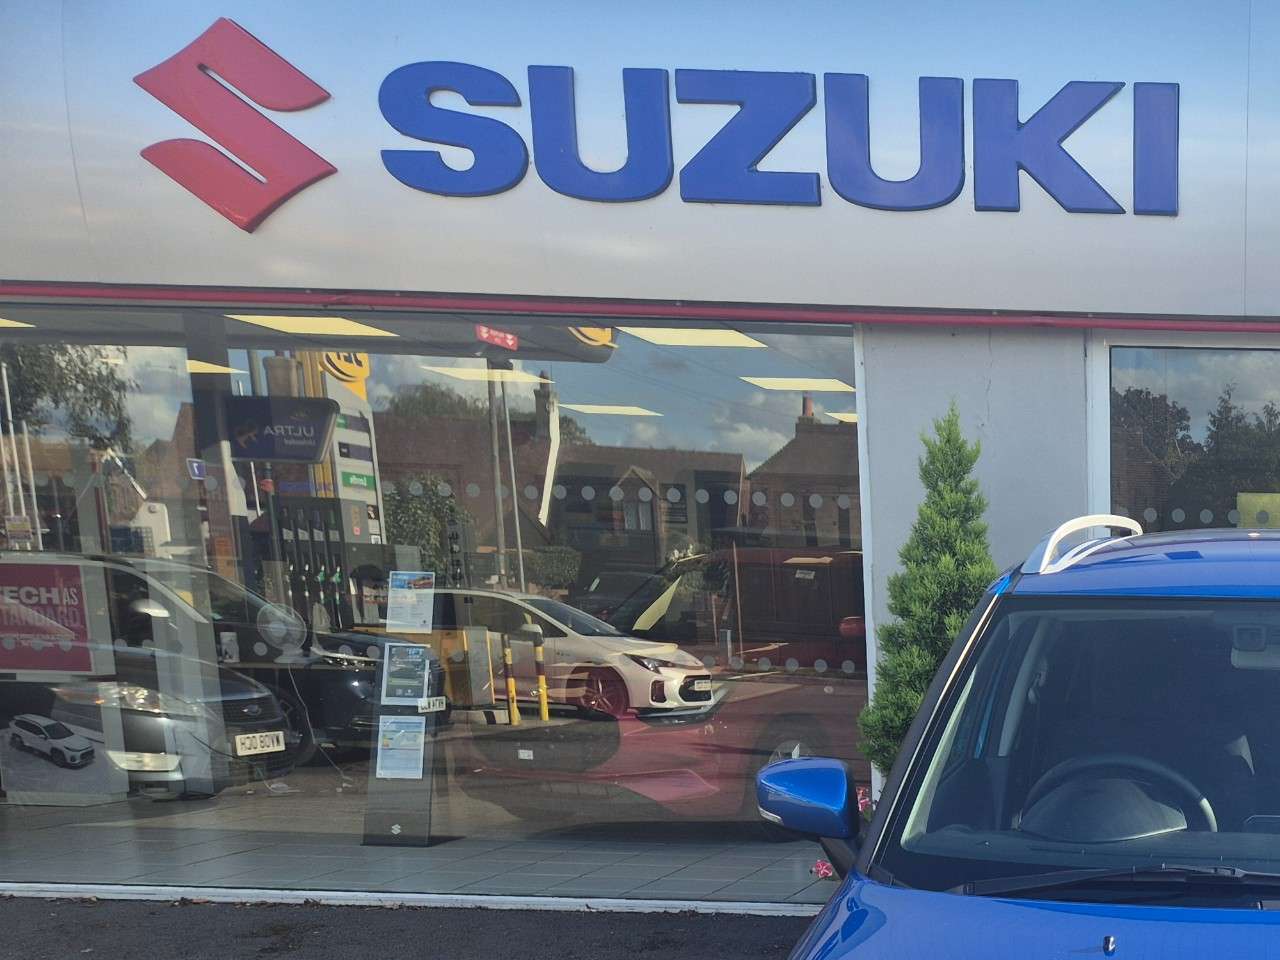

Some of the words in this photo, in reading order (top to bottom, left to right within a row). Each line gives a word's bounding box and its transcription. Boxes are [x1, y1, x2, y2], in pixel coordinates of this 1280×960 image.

[379, 60, 1181, 217] SUZUKI
[0, 586, 60, 605] ECH
[62, 587, 80, 606] AS
[0, 607, 82, 626] TANDARD
